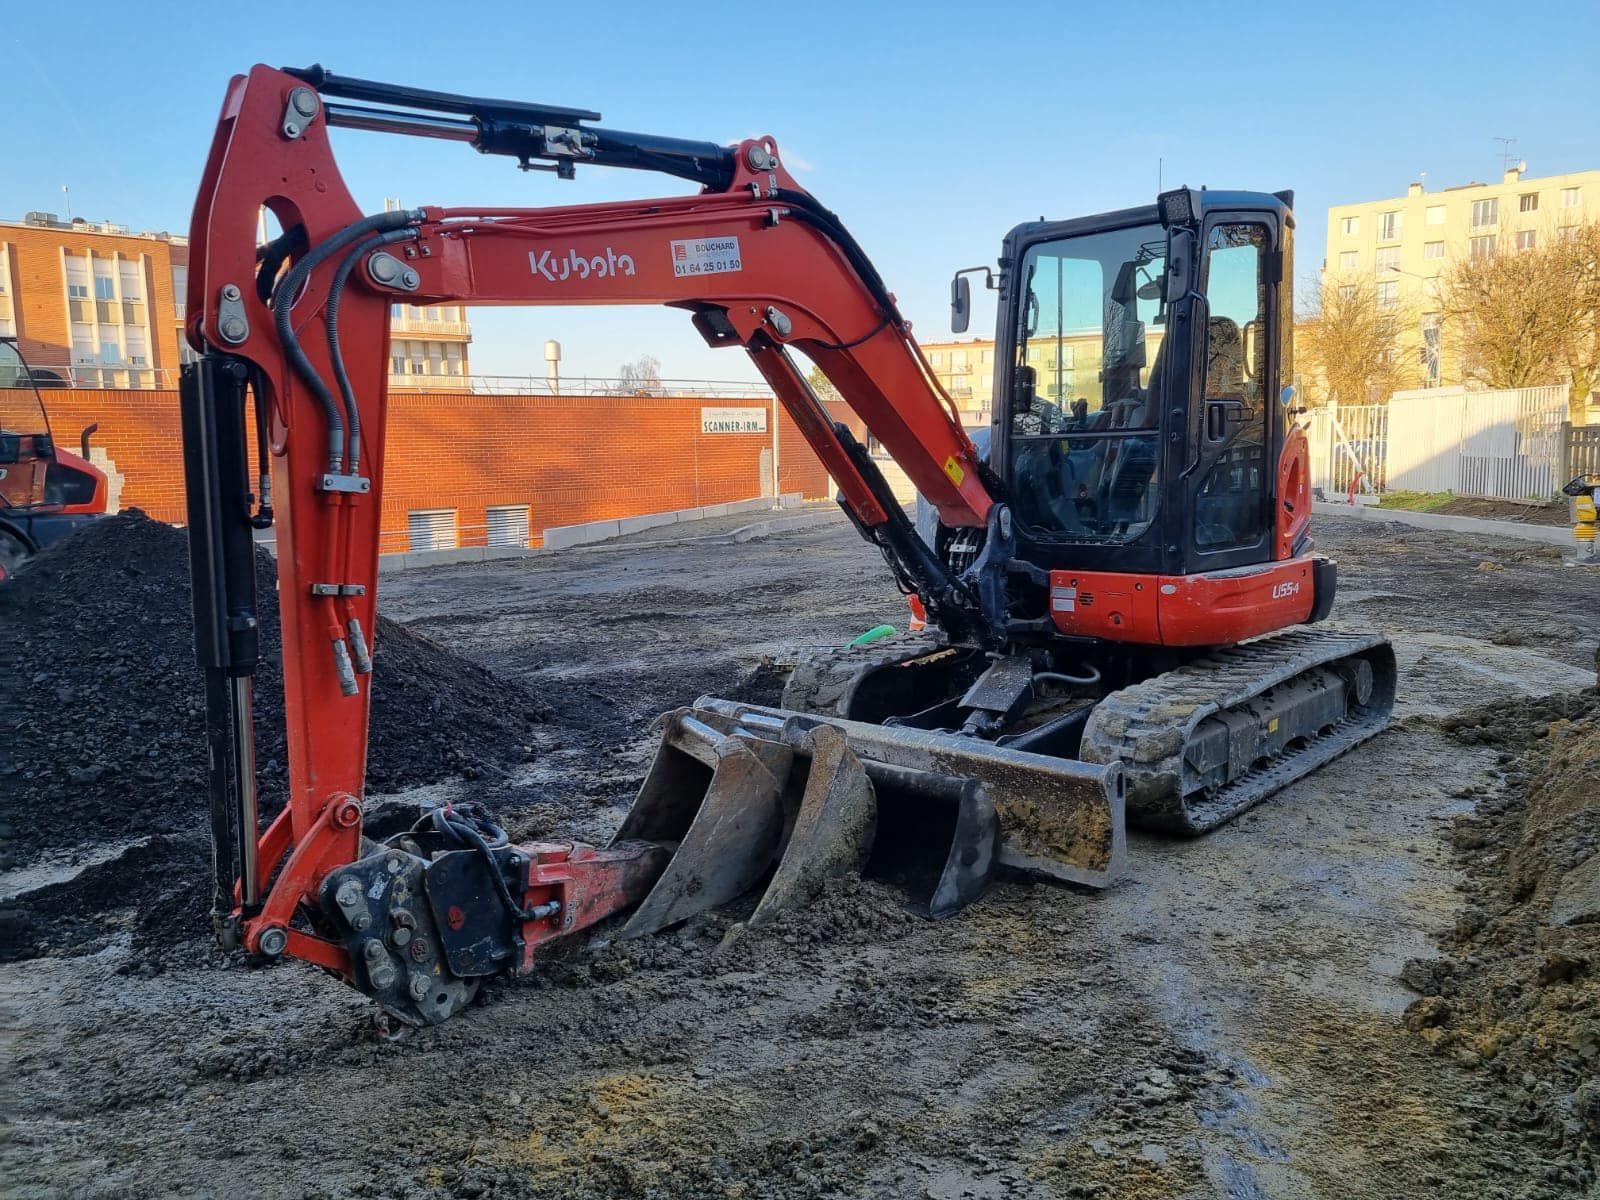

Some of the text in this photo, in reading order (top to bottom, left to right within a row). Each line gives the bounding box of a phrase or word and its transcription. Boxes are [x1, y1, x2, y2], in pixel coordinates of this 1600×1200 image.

[695, 242, 735, 252] BOUCHARD
[528, 247, 636, 281] Kubota
[675, 264, 686, 274] 01
[703, 262, 714, 272] 25
